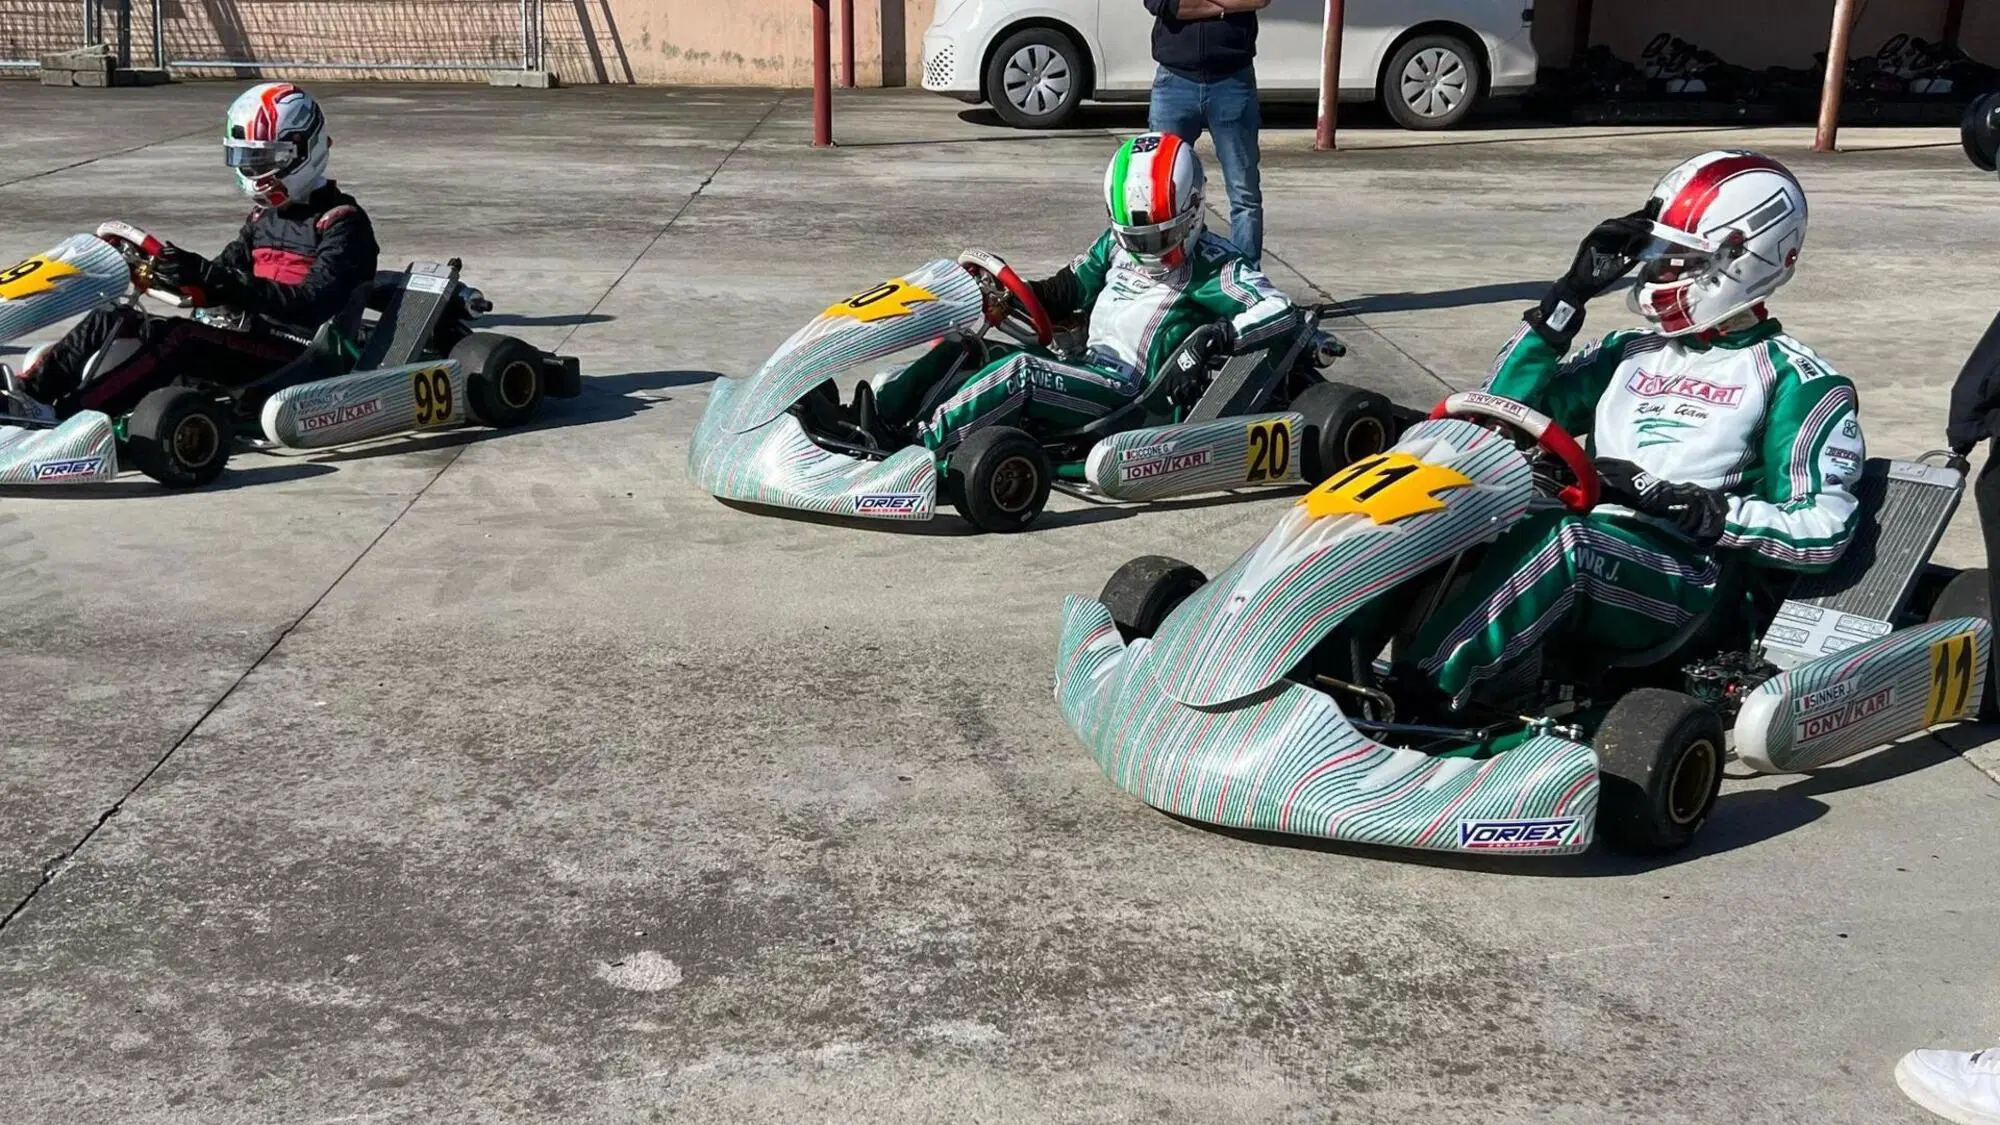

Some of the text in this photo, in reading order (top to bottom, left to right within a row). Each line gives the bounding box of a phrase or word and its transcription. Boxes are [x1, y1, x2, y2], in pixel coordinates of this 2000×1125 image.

[414, 369, 452, 425] 99
[32, 458, 102, 479] VORTEX
[1246, 422, 1291, 481] 20
[1326, 456, 1420, 503] 11
[855, 495, 921, 510] VORTEX
[1809, 683, 1845, 708] SINNER
[1931, 635, 1972, 724] 11
[1461, 820, 1576, 846] VORTEX
